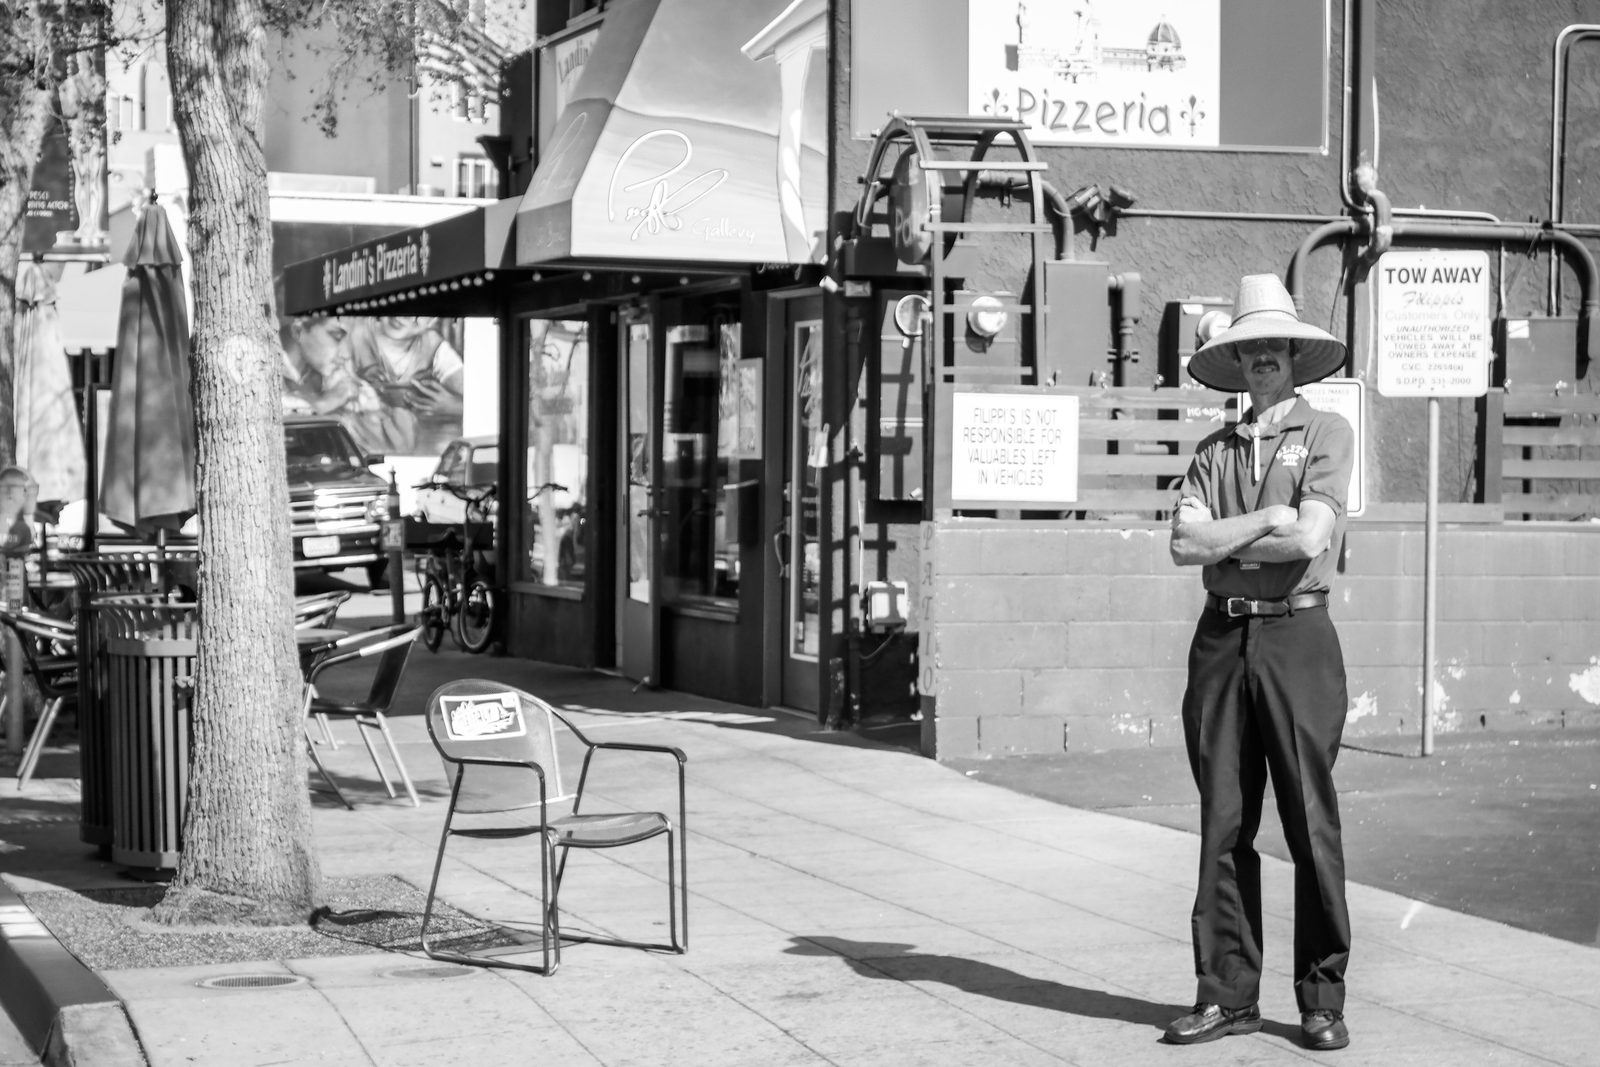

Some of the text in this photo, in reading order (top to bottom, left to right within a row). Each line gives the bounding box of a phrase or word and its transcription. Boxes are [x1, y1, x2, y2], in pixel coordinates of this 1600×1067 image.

[1017, 87, 1172, 135] Pizzeria
[333, 235, 418, 294] Landini's Pizzeria
[1384, 267, 1482, 285] TOW AWAY
[1384, 309, 1480, 322] Customers Only
[1383, 333, 1483, 341] VEHICLES WILL BE
[1396, 324, 1470, 333] UNAUTHORIZED
[1394, 342, 1471, 350] TOWED AWAY AT
[974, 407, 1057, 426] FILIPPI'S IS NOT
[963, 427, 1062, 445] RESPONSIBLE FOR
[968, 448, 1057, 465] VALUABLES LEFT
[978, 469, 1043, 486] IN VEHICLES
